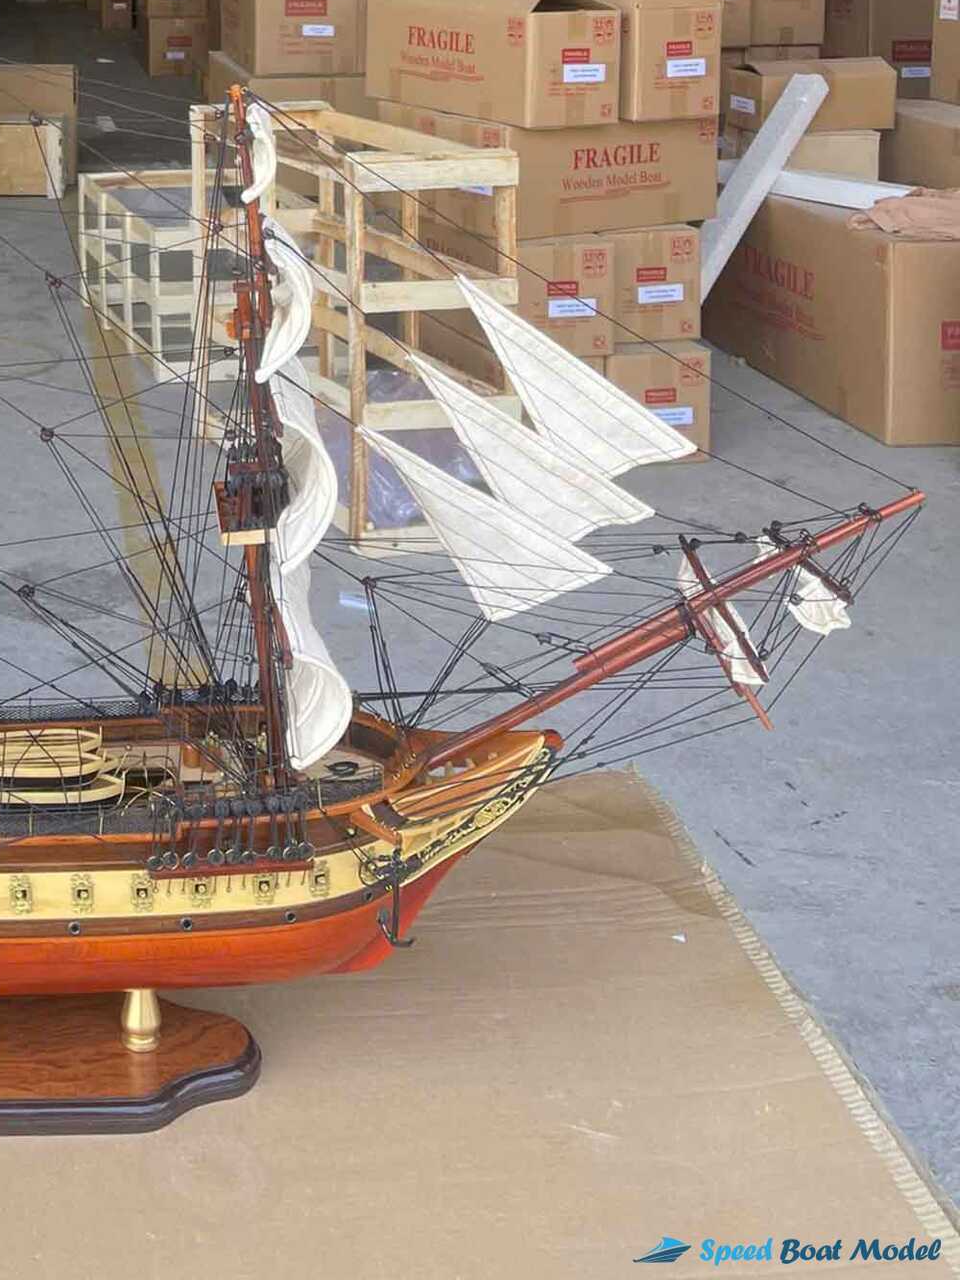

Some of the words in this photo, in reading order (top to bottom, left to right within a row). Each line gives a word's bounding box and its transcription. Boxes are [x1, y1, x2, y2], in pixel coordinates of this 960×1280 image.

[407, 25, 475, 55] FRAGILE
[573, 142, 661, 170] FRAGILE
[562, 175, 603, 191] Wooden
[606, 172, 638, 187] Model
[640, 170, 662, 184] Boat
